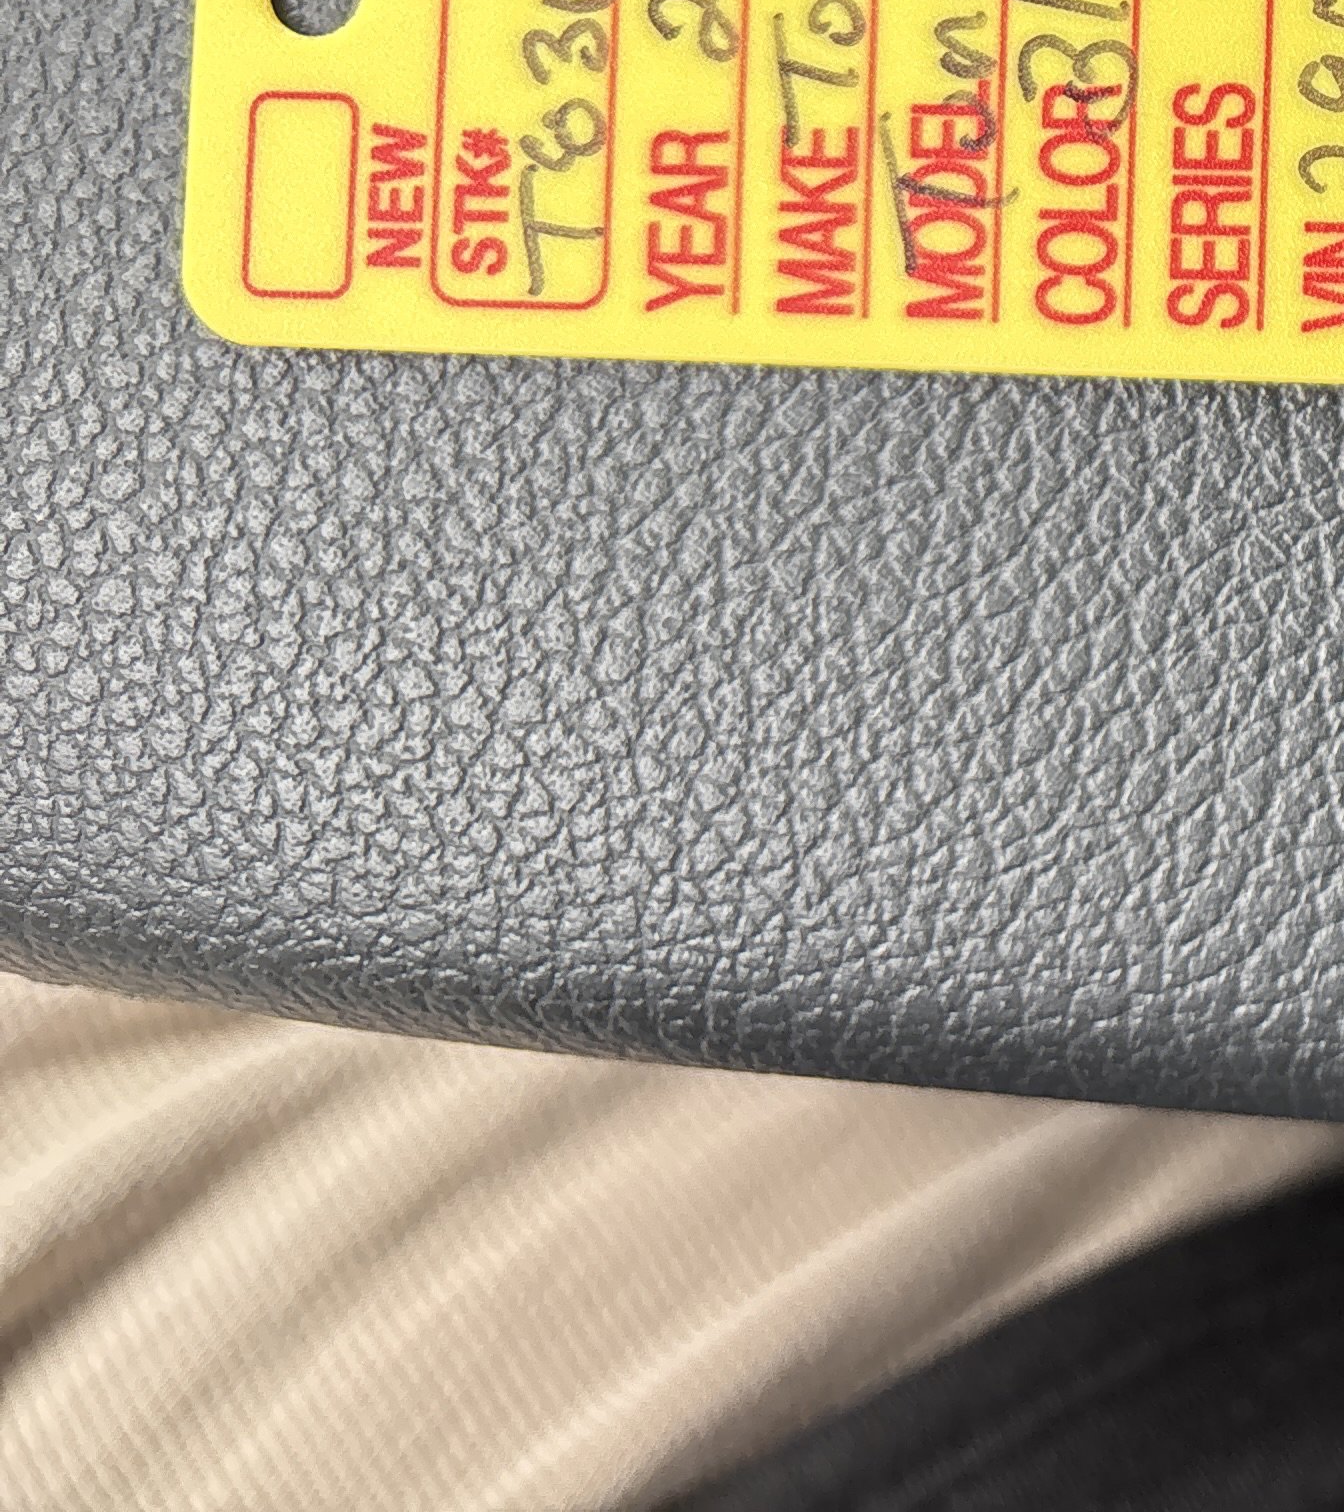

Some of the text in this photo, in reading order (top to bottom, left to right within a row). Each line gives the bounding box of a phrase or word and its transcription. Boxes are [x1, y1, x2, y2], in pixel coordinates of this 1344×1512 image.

[366, 123, 429, 269] NEW
[451, 126, 512, 276] STK#
[645, 127, 731, 312] YEAR
[774, 125, 862, 316] MAKE
[904, 77, 993, 320] MODEL
[1035, 82, 1122, 326] COLOR
[1166, 82, 1258, 330] SERIES
